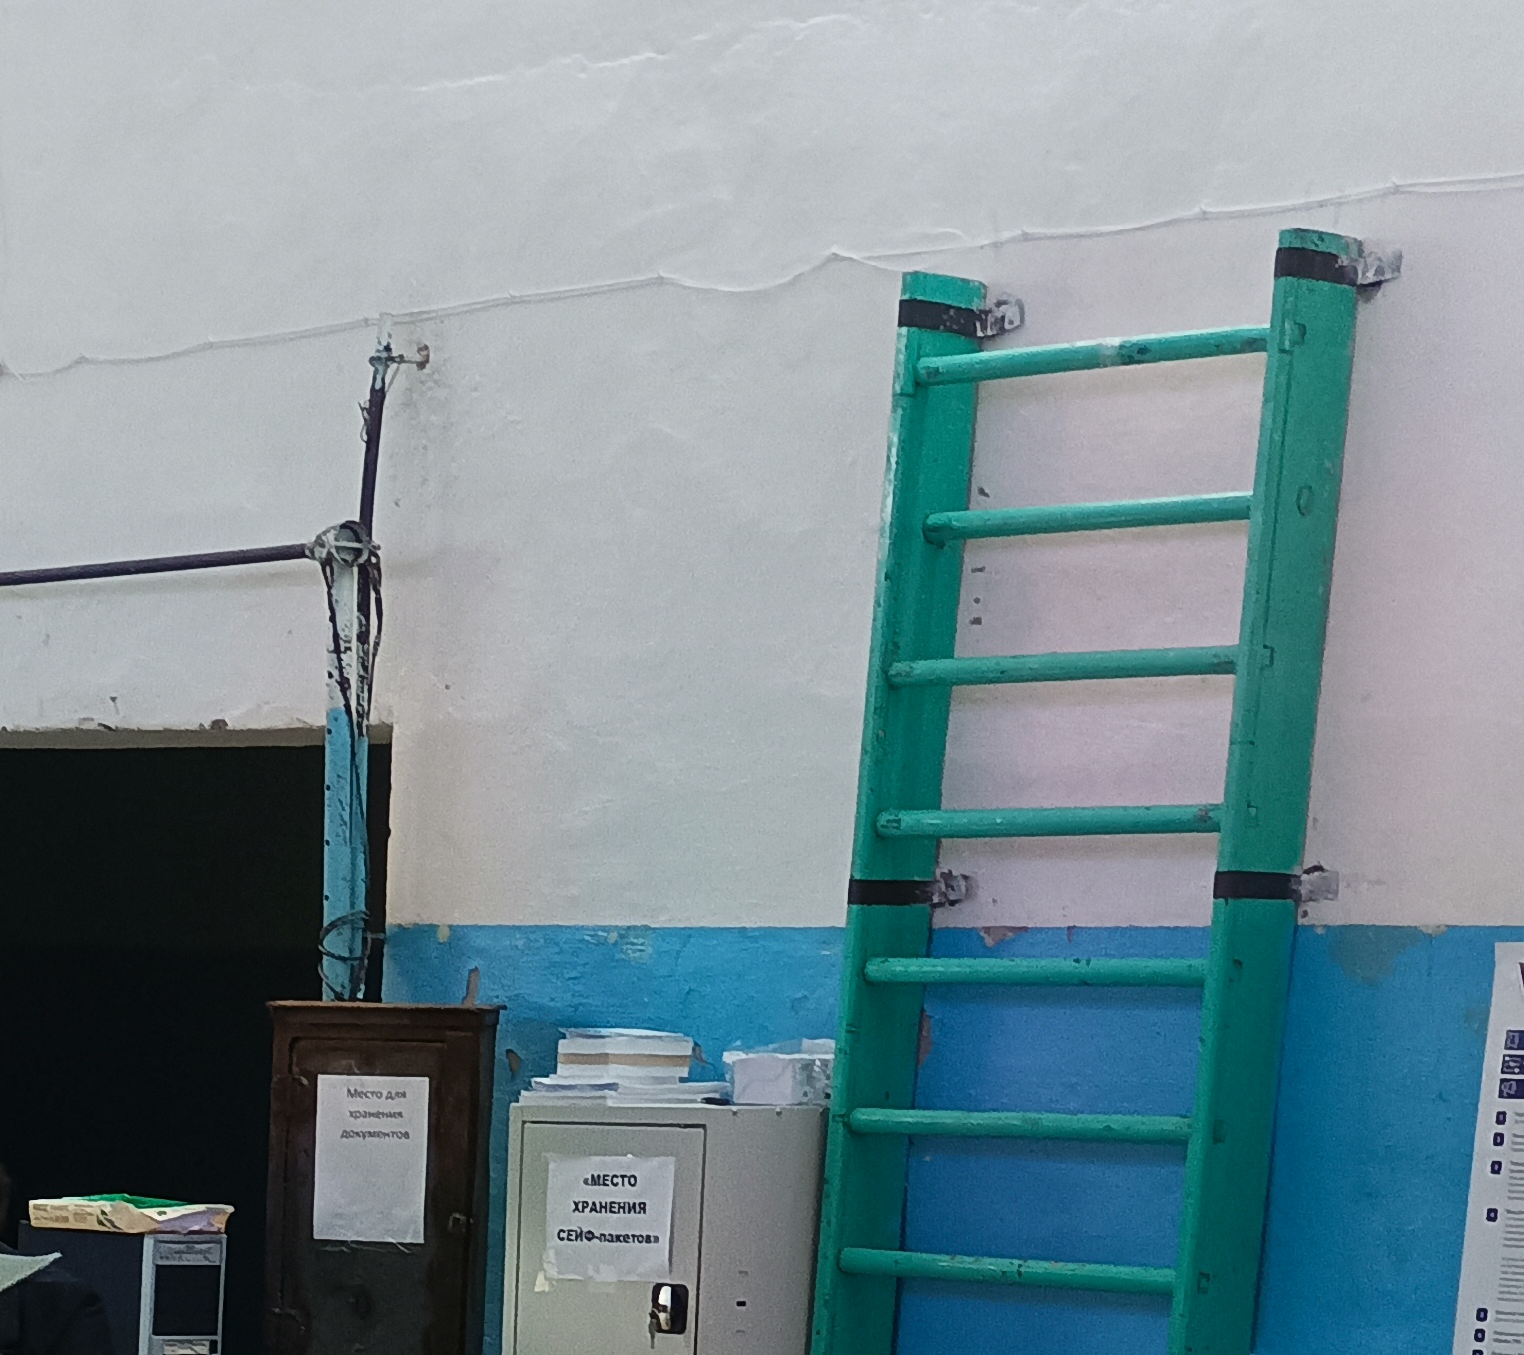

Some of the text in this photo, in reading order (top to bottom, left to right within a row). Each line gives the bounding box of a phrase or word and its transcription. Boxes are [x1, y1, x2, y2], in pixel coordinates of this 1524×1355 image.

[347, 1087, 383, 1100] Место
[582, 1173, 638, 1188] «МЕСТО
[571, 1200, 647, 1215] ХРАНЕНИЯ
